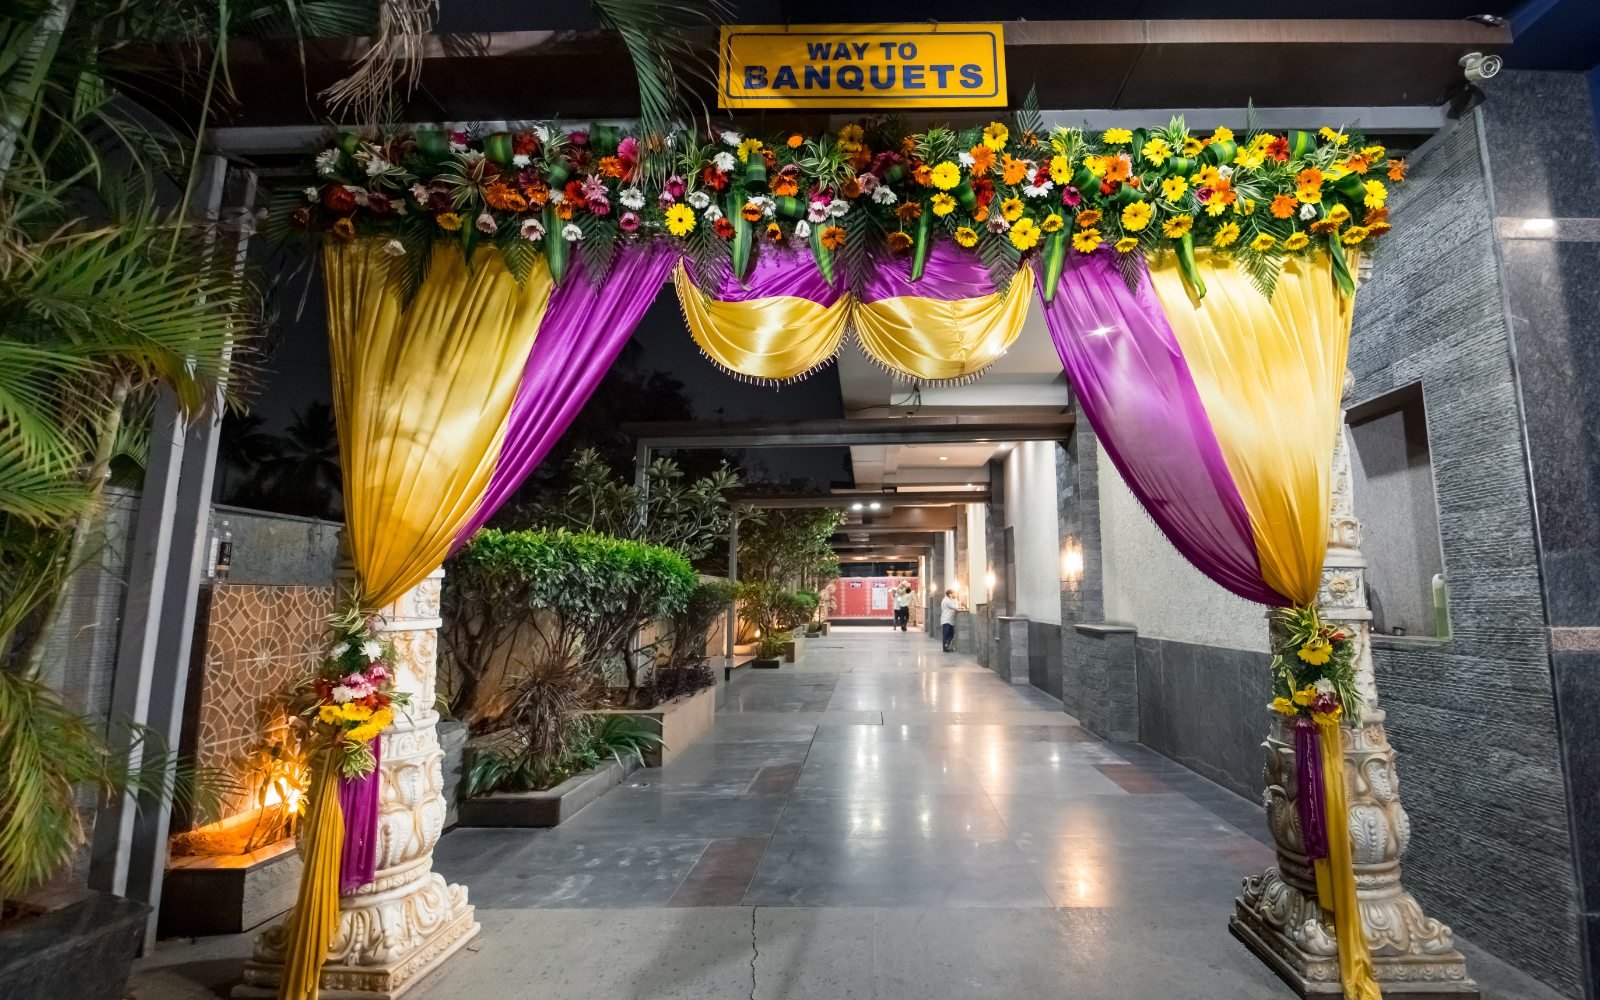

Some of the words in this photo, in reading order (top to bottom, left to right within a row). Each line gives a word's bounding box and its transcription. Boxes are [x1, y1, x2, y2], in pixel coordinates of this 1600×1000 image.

[807, 42, 870, 61] WAY
[879, 42, 918, 61] TO
[743, 64, 984, 91] BANQUETS
